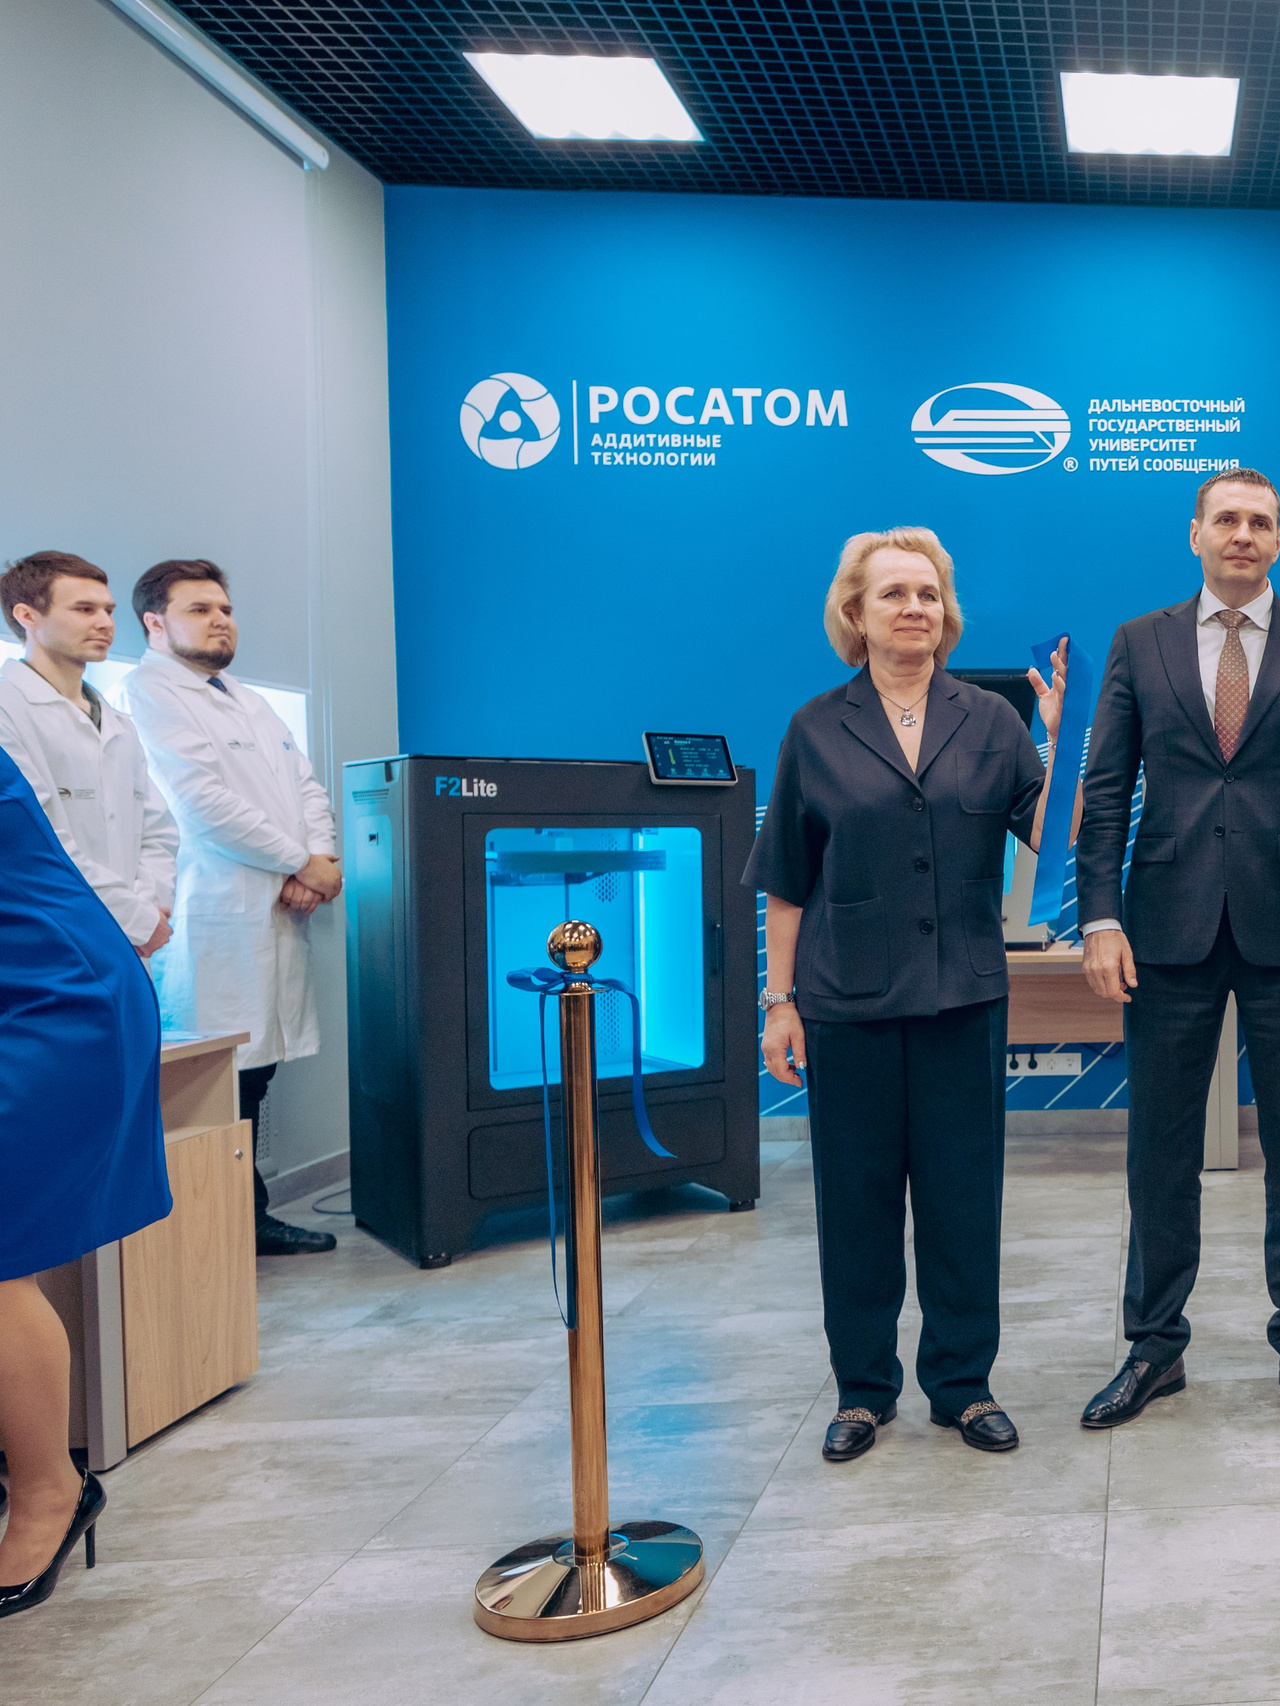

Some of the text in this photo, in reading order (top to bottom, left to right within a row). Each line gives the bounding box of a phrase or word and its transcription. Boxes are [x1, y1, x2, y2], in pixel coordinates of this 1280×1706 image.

[588, 385, 849, 427] РОСАТОМ
[1088, 397, 1246, 413] ДАЛЬНЕВОСТОЧНЫЙ
[1088, 418, 1241, 433] ГОСУДАРСТВЕННЫЙ
[590, 433, 722, 449] АДДИТИВНЫЕ
[1088, 438, 1197, 452] УНИВЕРСИТЕТ
[590, 451, 716, 466] ТЕХНОЛОГИИ
[1089, 456, 1240, 474] ПУТЕЙ СООБЩЕНИЯ
[435, 776, 498, 798] F2Lite
